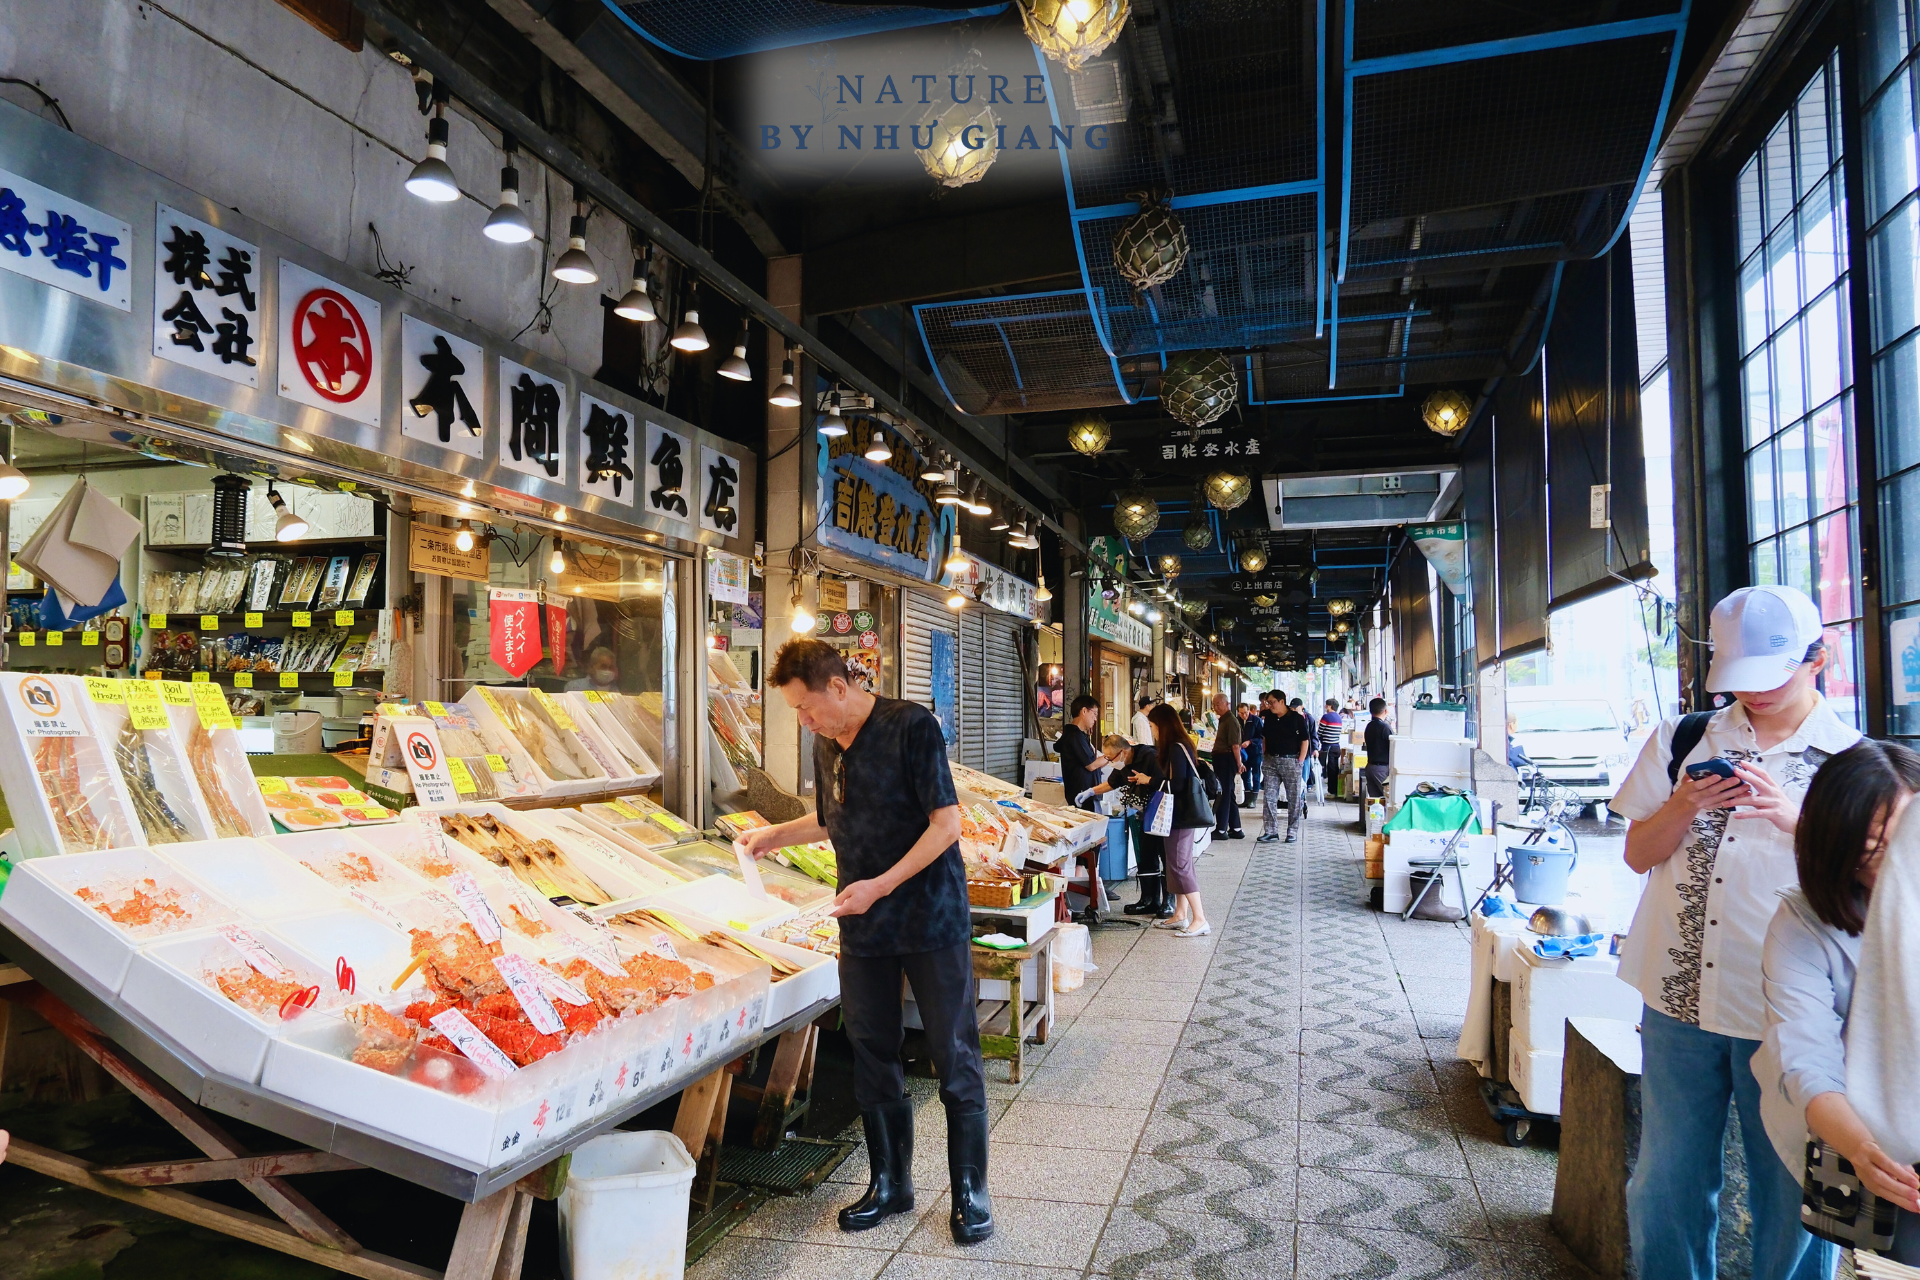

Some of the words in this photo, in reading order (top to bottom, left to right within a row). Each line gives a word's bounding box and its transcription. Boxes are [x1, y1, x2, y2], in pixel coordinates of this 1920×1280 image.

[162, 225, 257, 312] 株式
[162, 290, 258, 367] 会社
[1414, 525, 1458, 536] 二条市場
[420, 538, 482, 560] 二条市場組合盟店
[1244, 581, 1283, 590] 上出商店
[515, 607, 526, 653] ペイペイ
[504, 615, 516, 668] 使えます。
[163, 683, 182, 694] Boil
[33, 720, 67, 728] 撮影禁止
[37, 728, 81, 736] Photography
[418, 773, 441, 781] 撮影禁止
[422, 780, 450, 788] Photography
